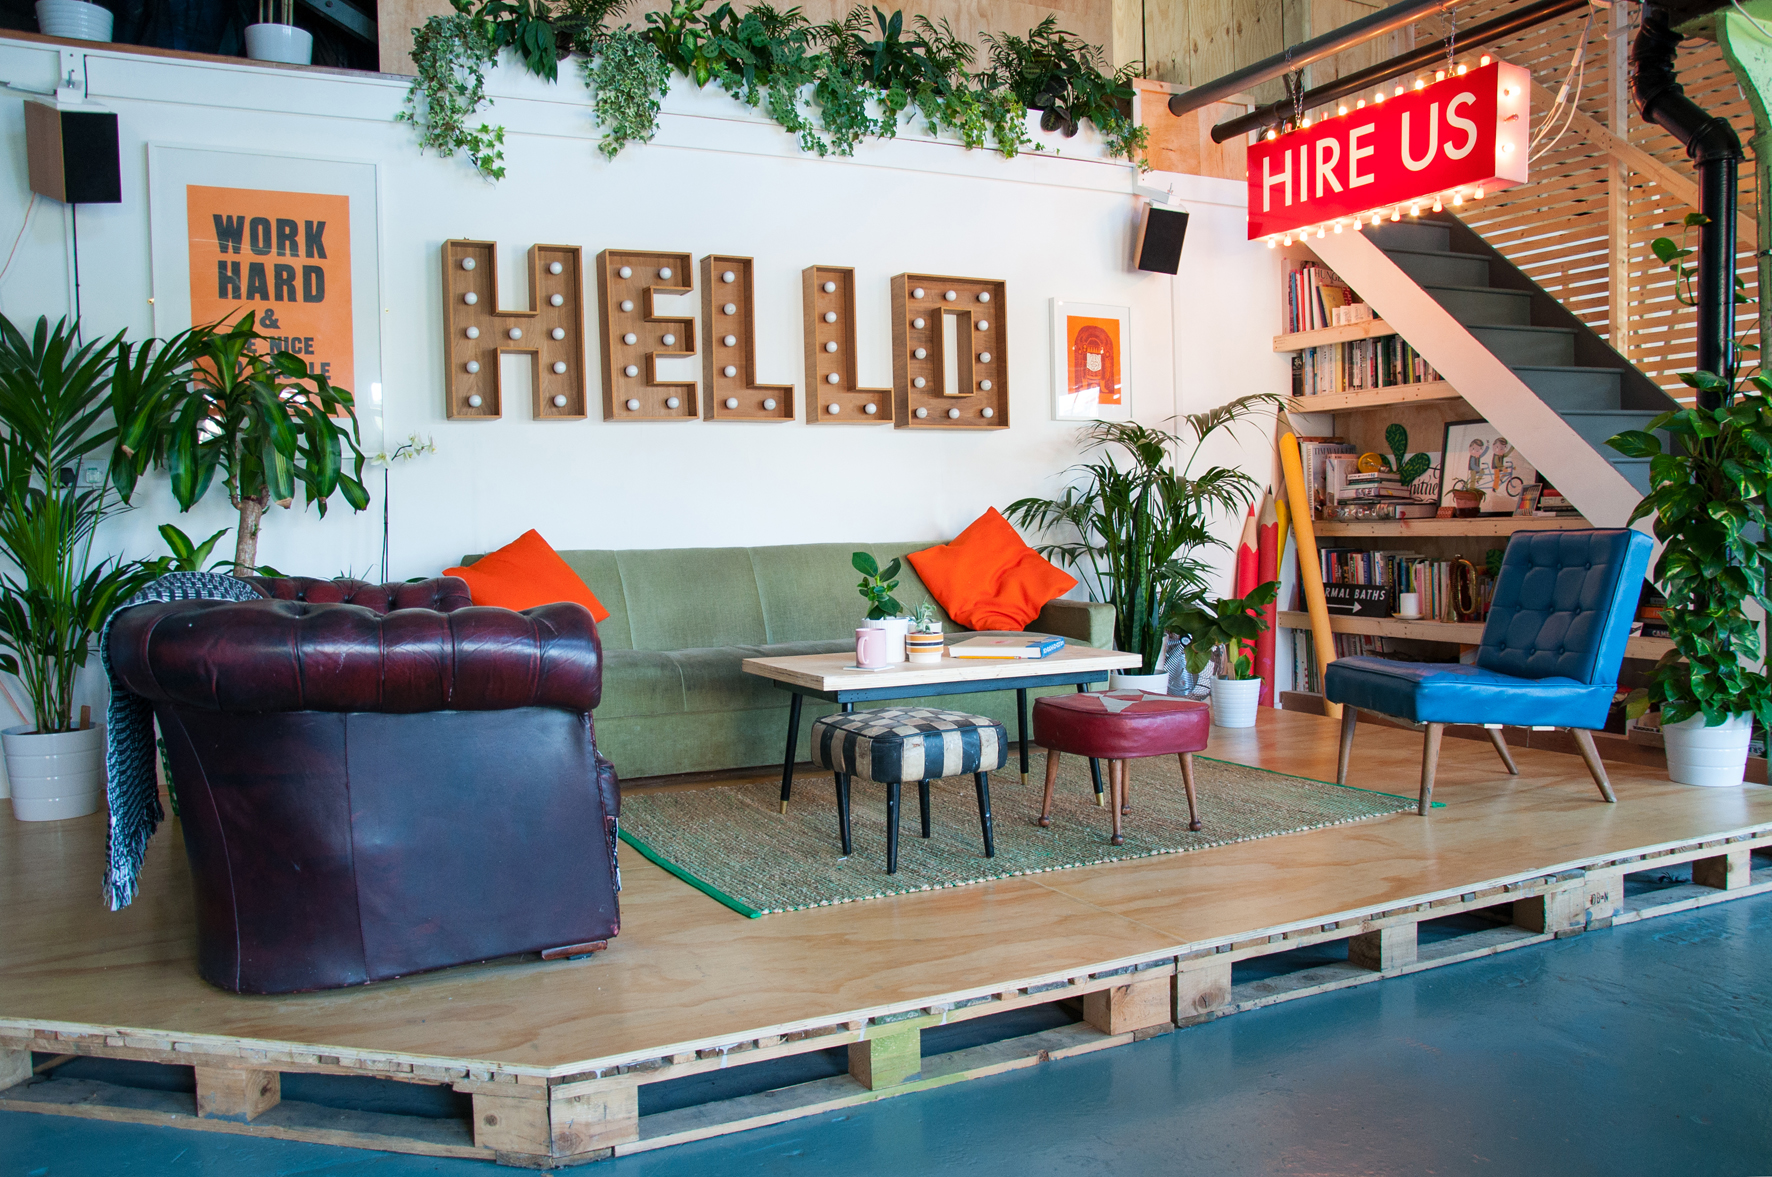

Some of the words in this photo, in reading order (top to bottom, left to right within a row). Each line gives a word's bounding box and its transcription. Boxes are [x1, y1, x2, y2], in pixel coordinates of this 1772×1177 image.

[1263, 122, 1375, 212] HIRE
[1401, 91, 1477, 171] US
[212, 213, 328, 259] WORK
[217, 260, 326, 303] HARD
[259, 308, 281, 329] &
[441, 239, 1010, 430] HELLO
[269, 336, 315, 355] NICE
[1325, 587, 1350, 598] RMAL
[1353, 588, 1386, 600] BATHS
